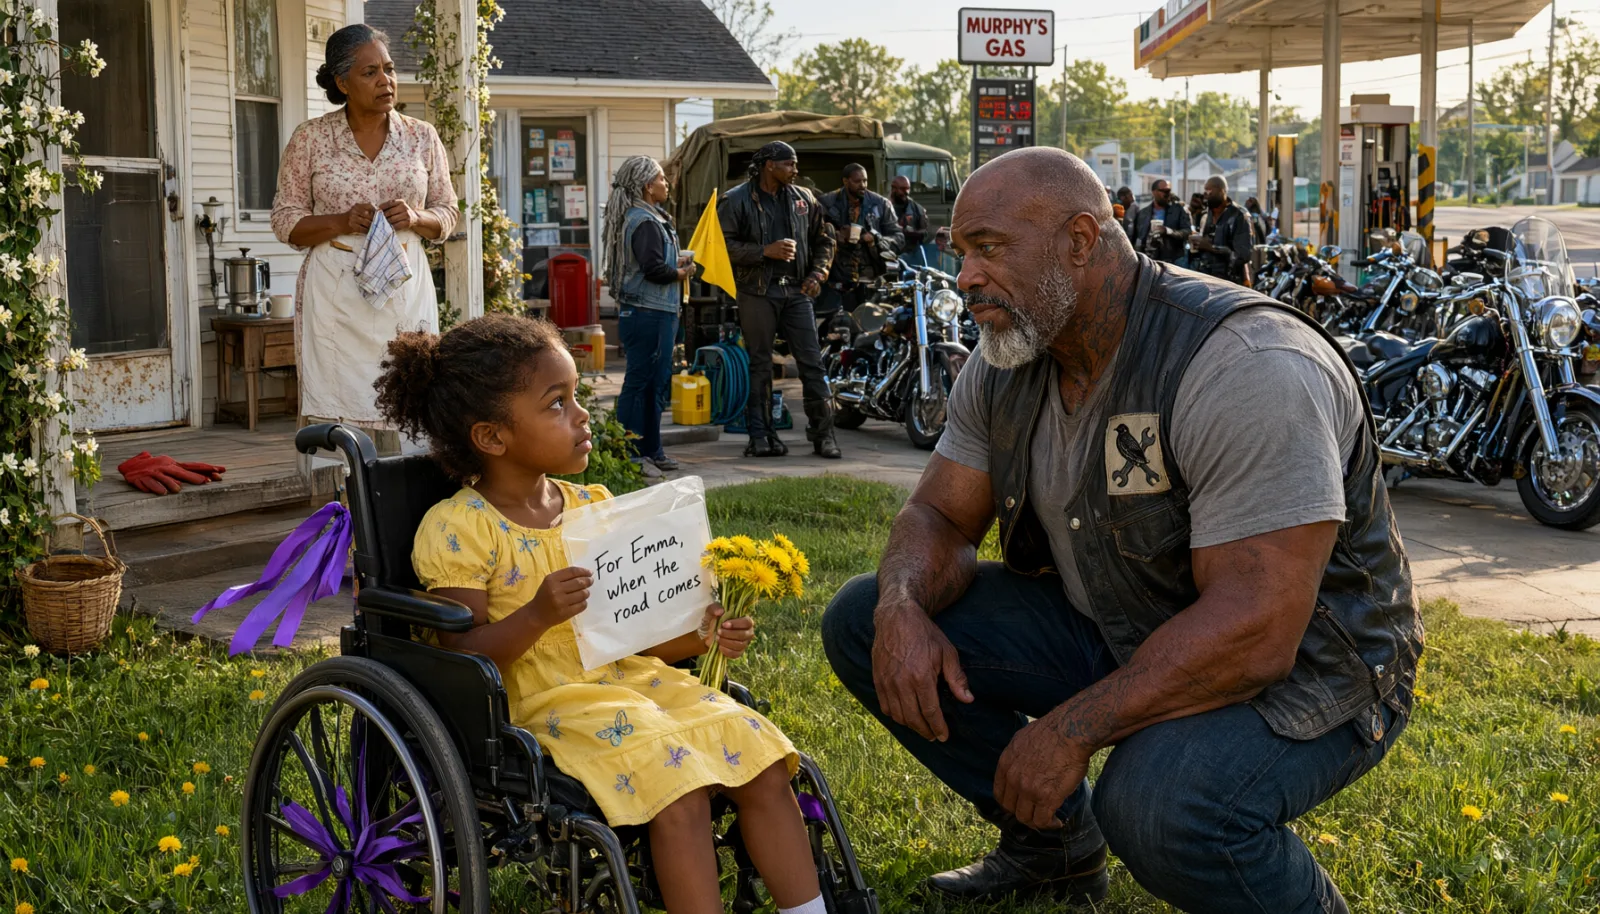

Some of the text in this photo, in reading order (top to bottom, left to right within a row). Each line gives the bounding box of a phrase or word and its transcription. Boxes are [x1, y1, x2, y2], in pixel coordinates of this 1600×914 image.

[967, 17, 1048, 35] MURPHY'S
[985, 38, 1026, 57] GAS
[594, 535, 684, 580] For Emma,
[607, 558, 680, 601] when the
[614, 574, 702, 624] road comes
